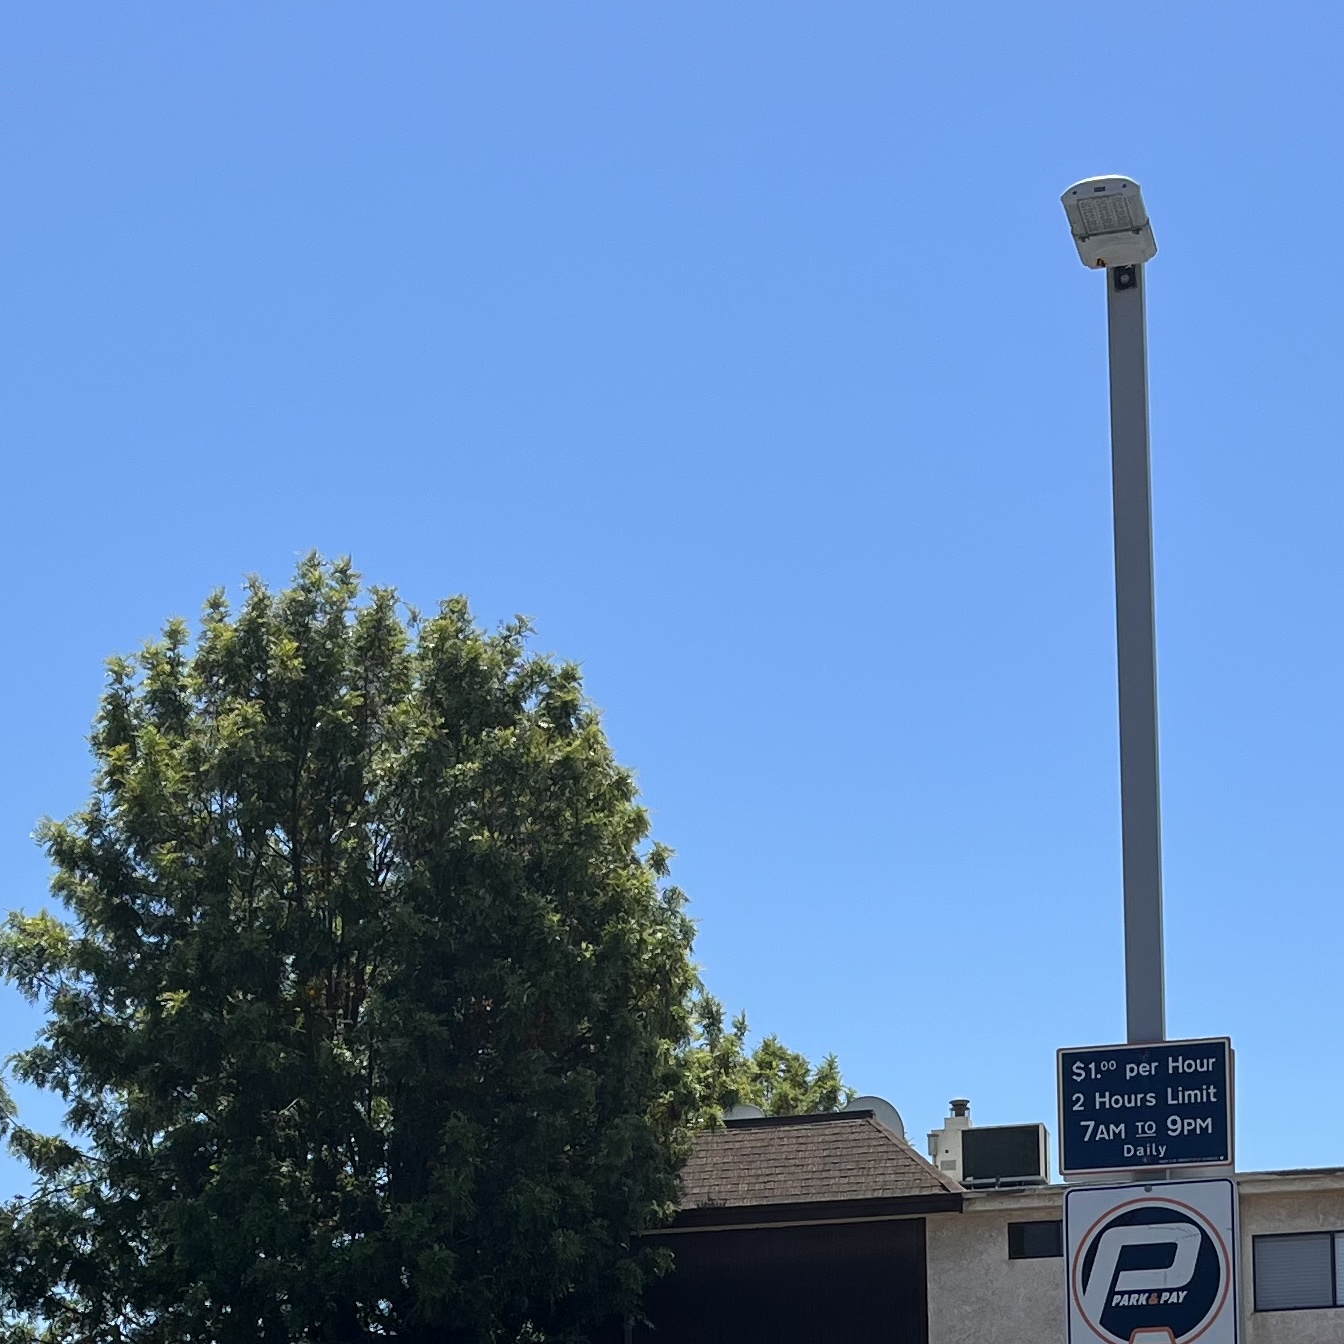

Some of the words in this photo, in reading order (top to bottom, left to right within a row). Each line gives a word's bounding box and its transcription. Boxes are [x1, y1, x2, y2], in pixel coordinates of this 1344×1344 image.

[1072, 1060, 1117, 1082] $1.00
[1126, 1062, 1158, 1080] per
[1168, 1056, 1216, 1074] Hour
[1072, 1093, 1084, 1111] 2
[1095, 1092, 1156, 1109] Hours
[1167, 1085, 1217, 1104] Limit
[1080, 1120, 1125, 1142] 7AM
[1136, 1122, 1156, 1134] TO
[1167, 1115, 1212, 1136] 9PM
[1124, 1143, 1166, 1157] Daily
